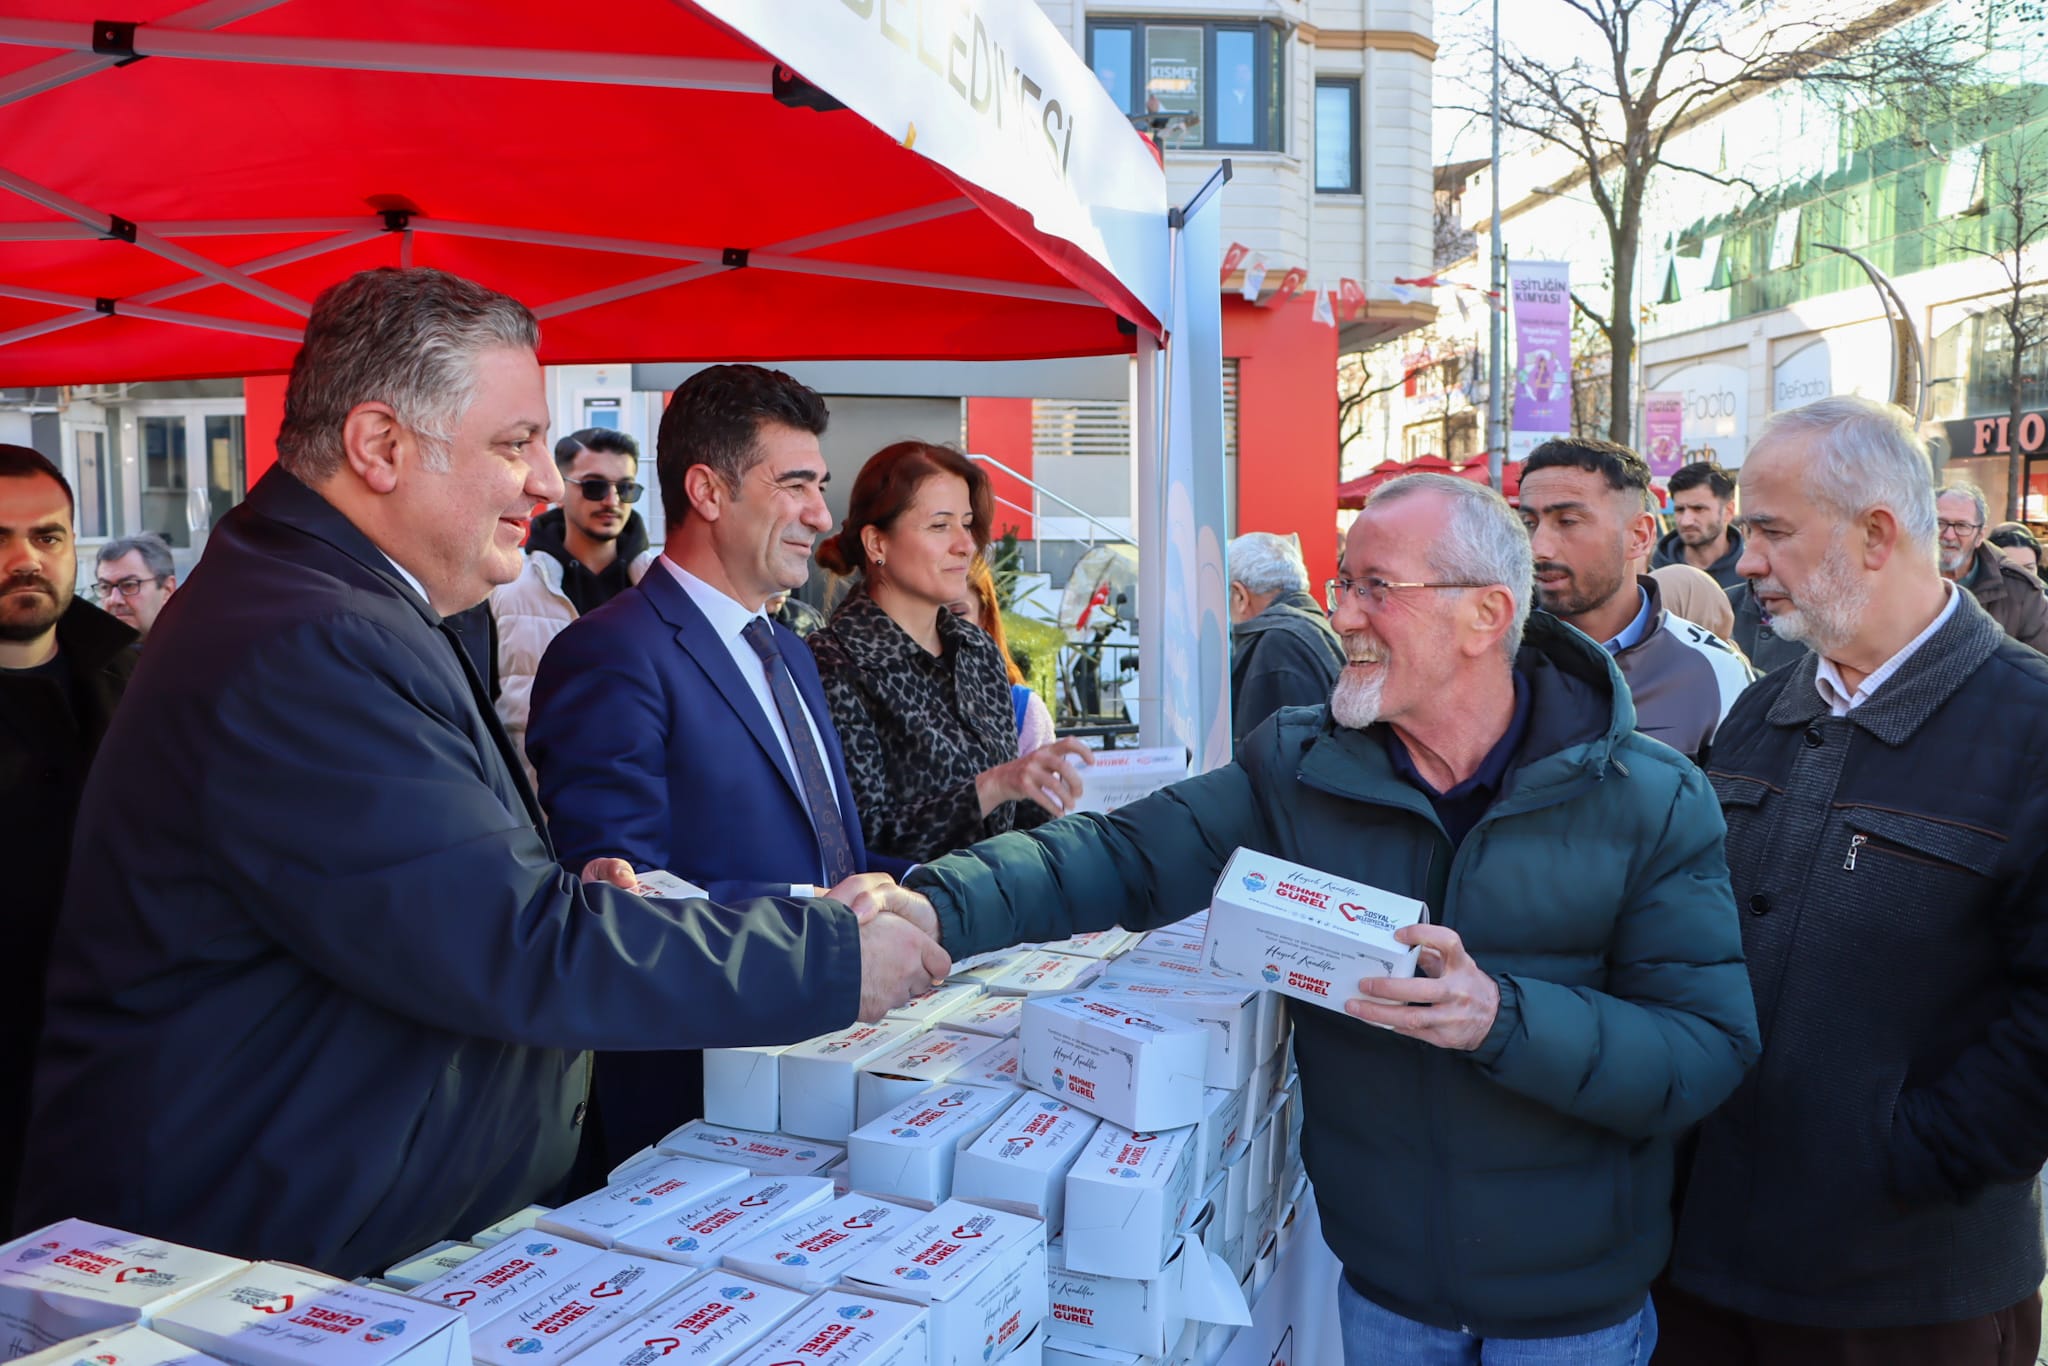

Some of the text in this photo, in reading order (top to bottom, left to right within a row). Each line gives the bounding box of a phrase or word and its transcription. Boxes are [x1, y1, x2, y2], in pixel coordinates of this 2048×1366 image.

[1278, 881, 1332, 901] MEHMET
[1364, 911, 1389, 922] SOSYAL
[1288, 971, 1331, 988] MEHMET
[1068, 1073, 1096, 1091] MEHMET
[688, 1207, 733, 1232] MEHMET
[795, 1228, 838, 1249] MEHMET
[68, 1248, 125, 1267] MEHMET
[911, 1239, 949, 1263] MEHMET
[488, 1261, 537, 1289] MEHMET
[531, 1299, 582, 1332] MEHMET
[1053, 1302, 1095, 1316] MEHMET
[288, 1316, 352, 1335] MEHMET
[689, 1305, 736, 1336] MEHMET
[813, 1326, 857, 1357] MEHMET
